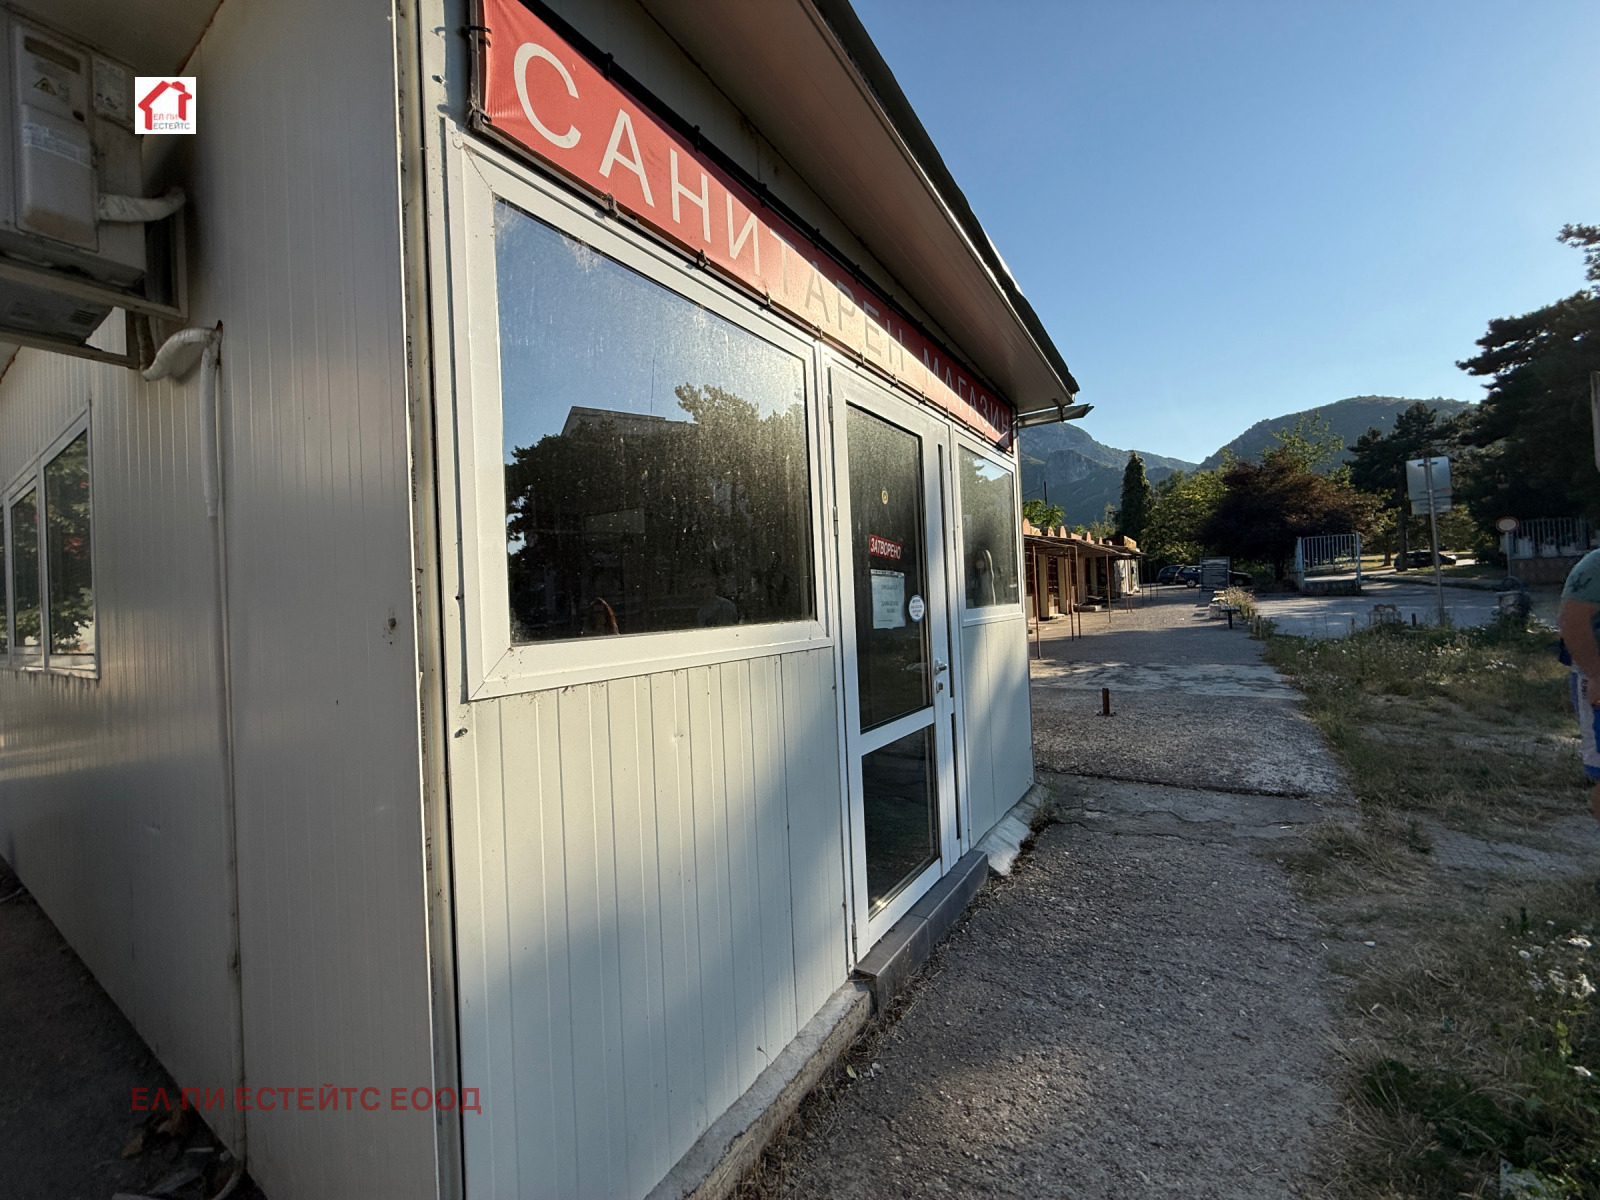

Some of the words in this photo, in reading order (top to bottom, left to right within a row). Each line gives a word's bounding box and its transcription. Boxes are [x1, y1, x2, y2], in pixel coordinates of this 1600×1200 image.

[513, 42, 904, 371] САНИТАРЕН
[923, 348, 1009, 442] МАГАЗИН
[870, 538, 902, 560] ЗАТВОРЕНО
